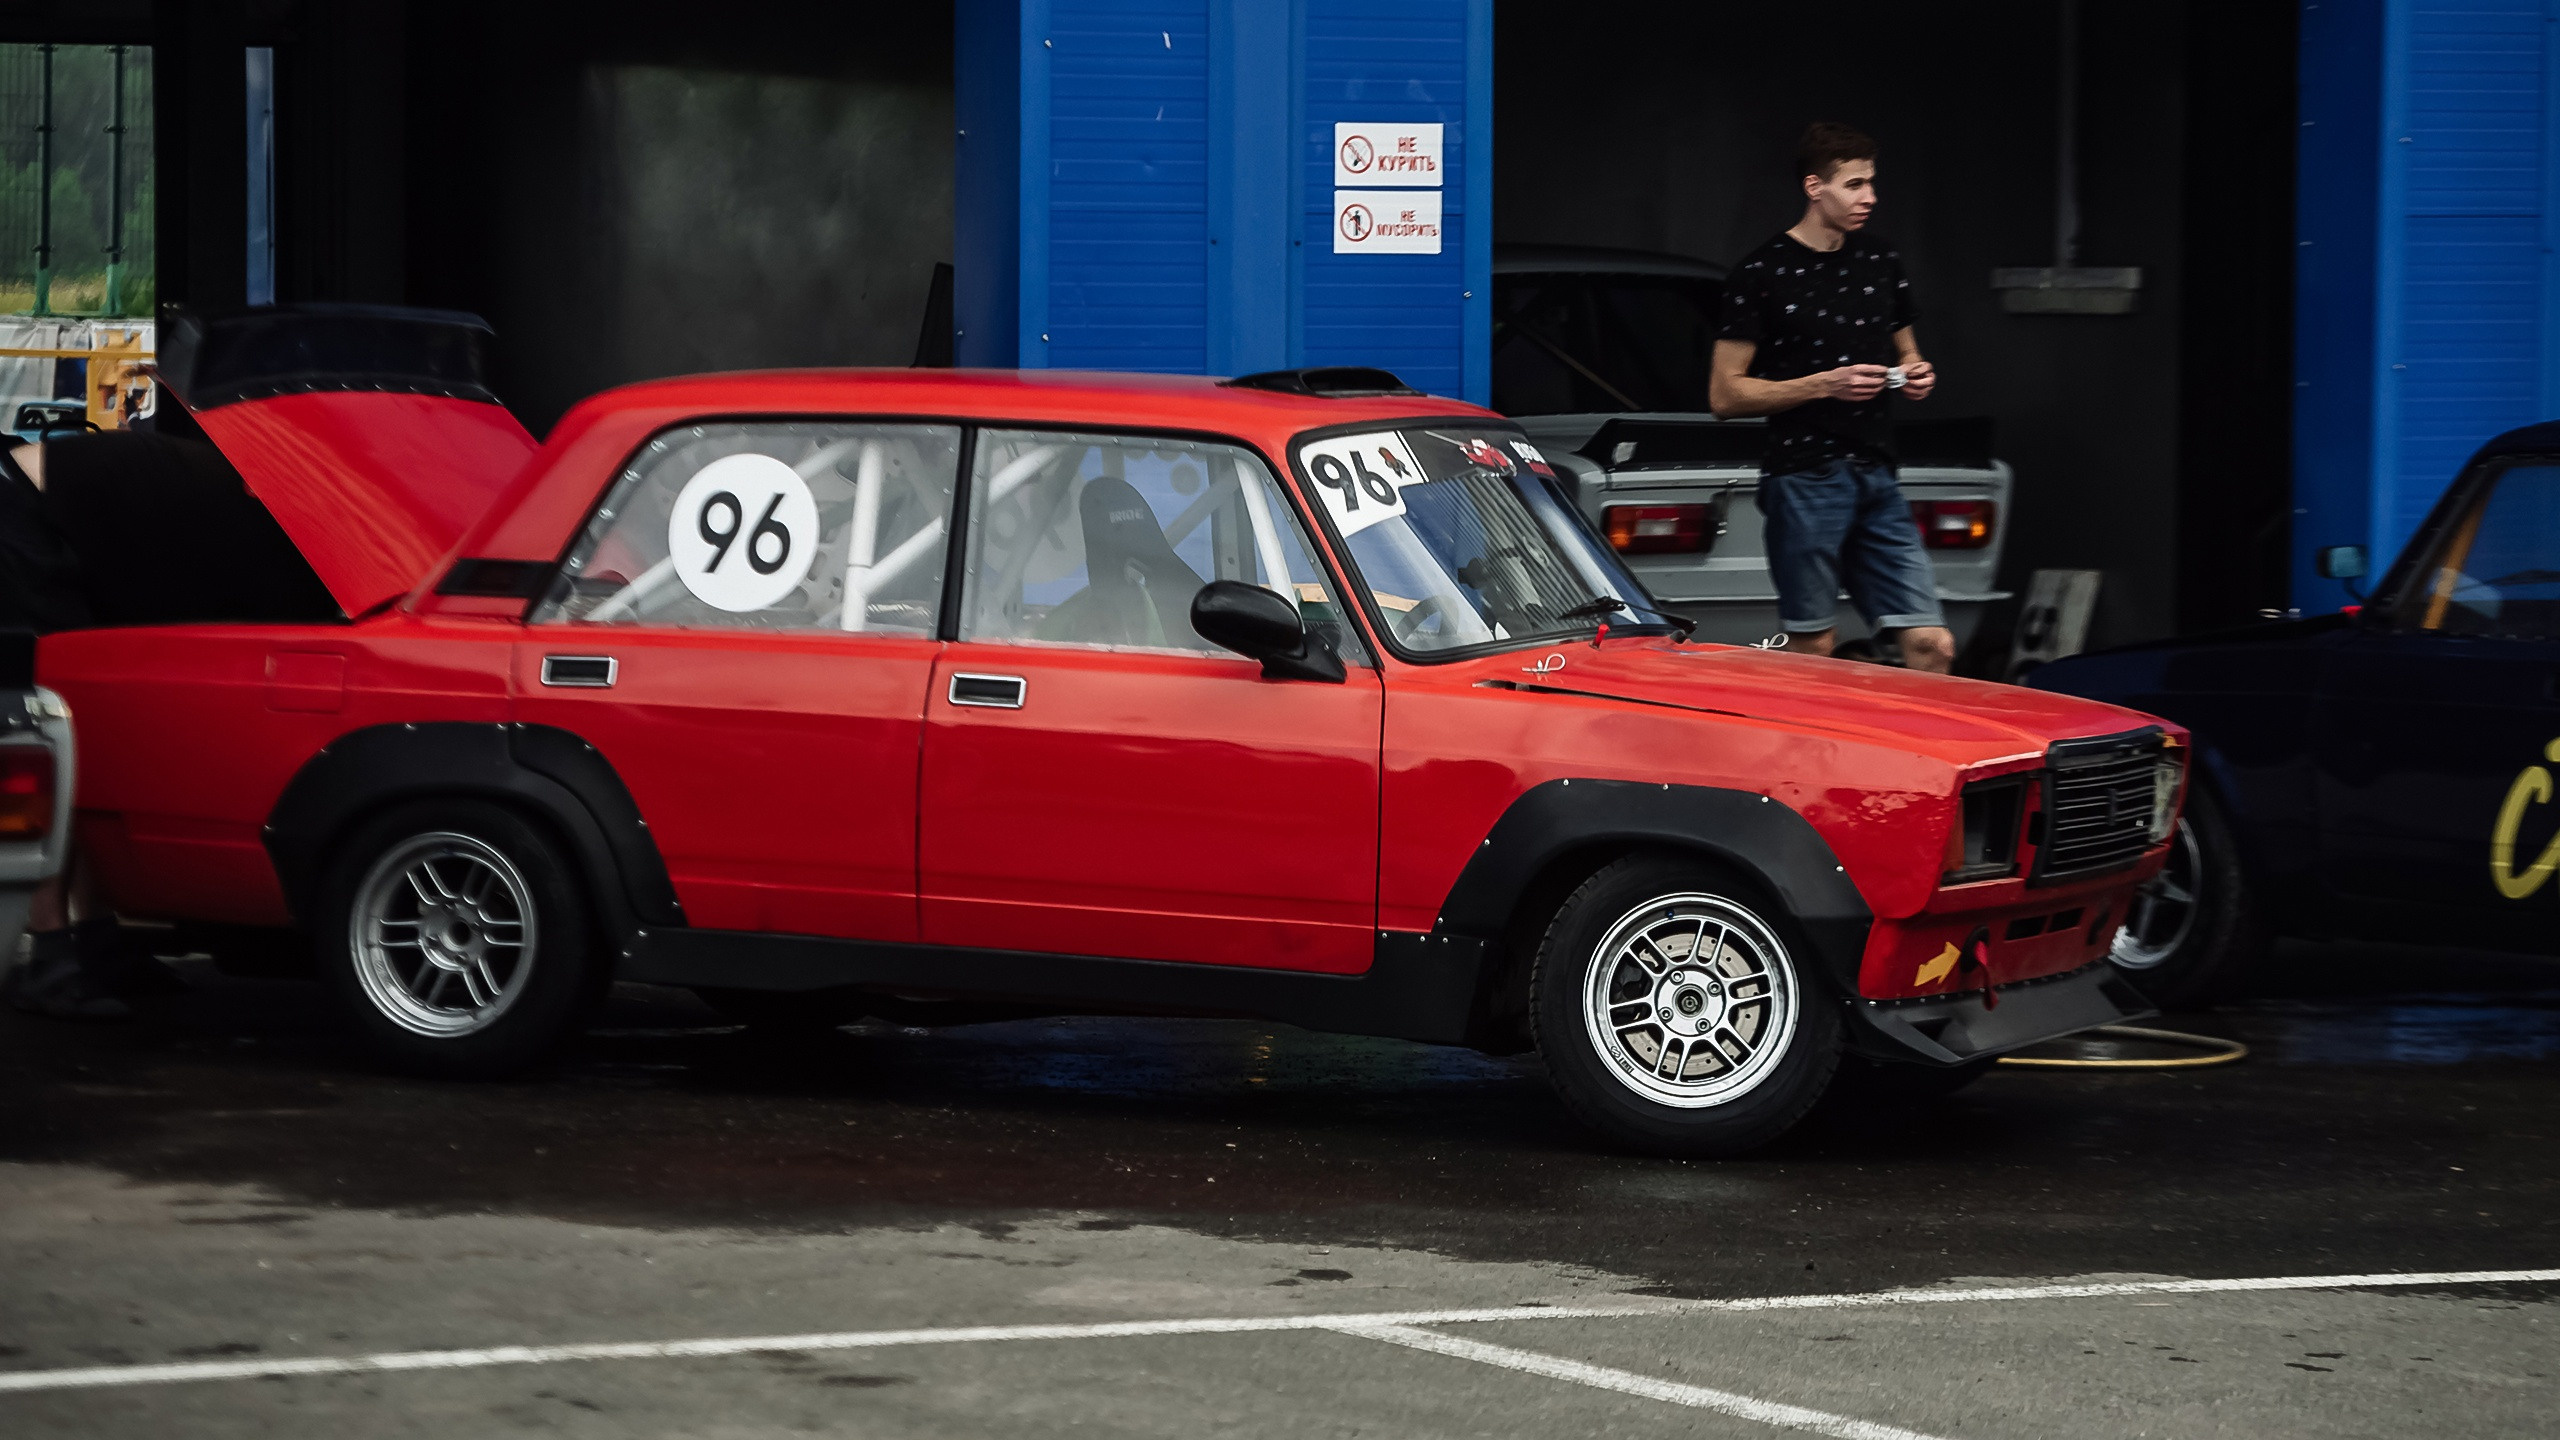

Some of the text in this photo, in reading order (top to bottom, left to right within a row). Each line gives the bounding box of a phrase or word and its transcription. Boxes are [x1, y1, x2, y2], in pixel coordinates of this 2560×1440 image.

[1398, 137, 1417, 153] НЕ
[1378, 155, 1436, 171] КУРИТЬ
[1400, 210, 1416, 222] НЕ
[1311, 450, 1397, 513] 96
[698, 490, 791, 575] 96
